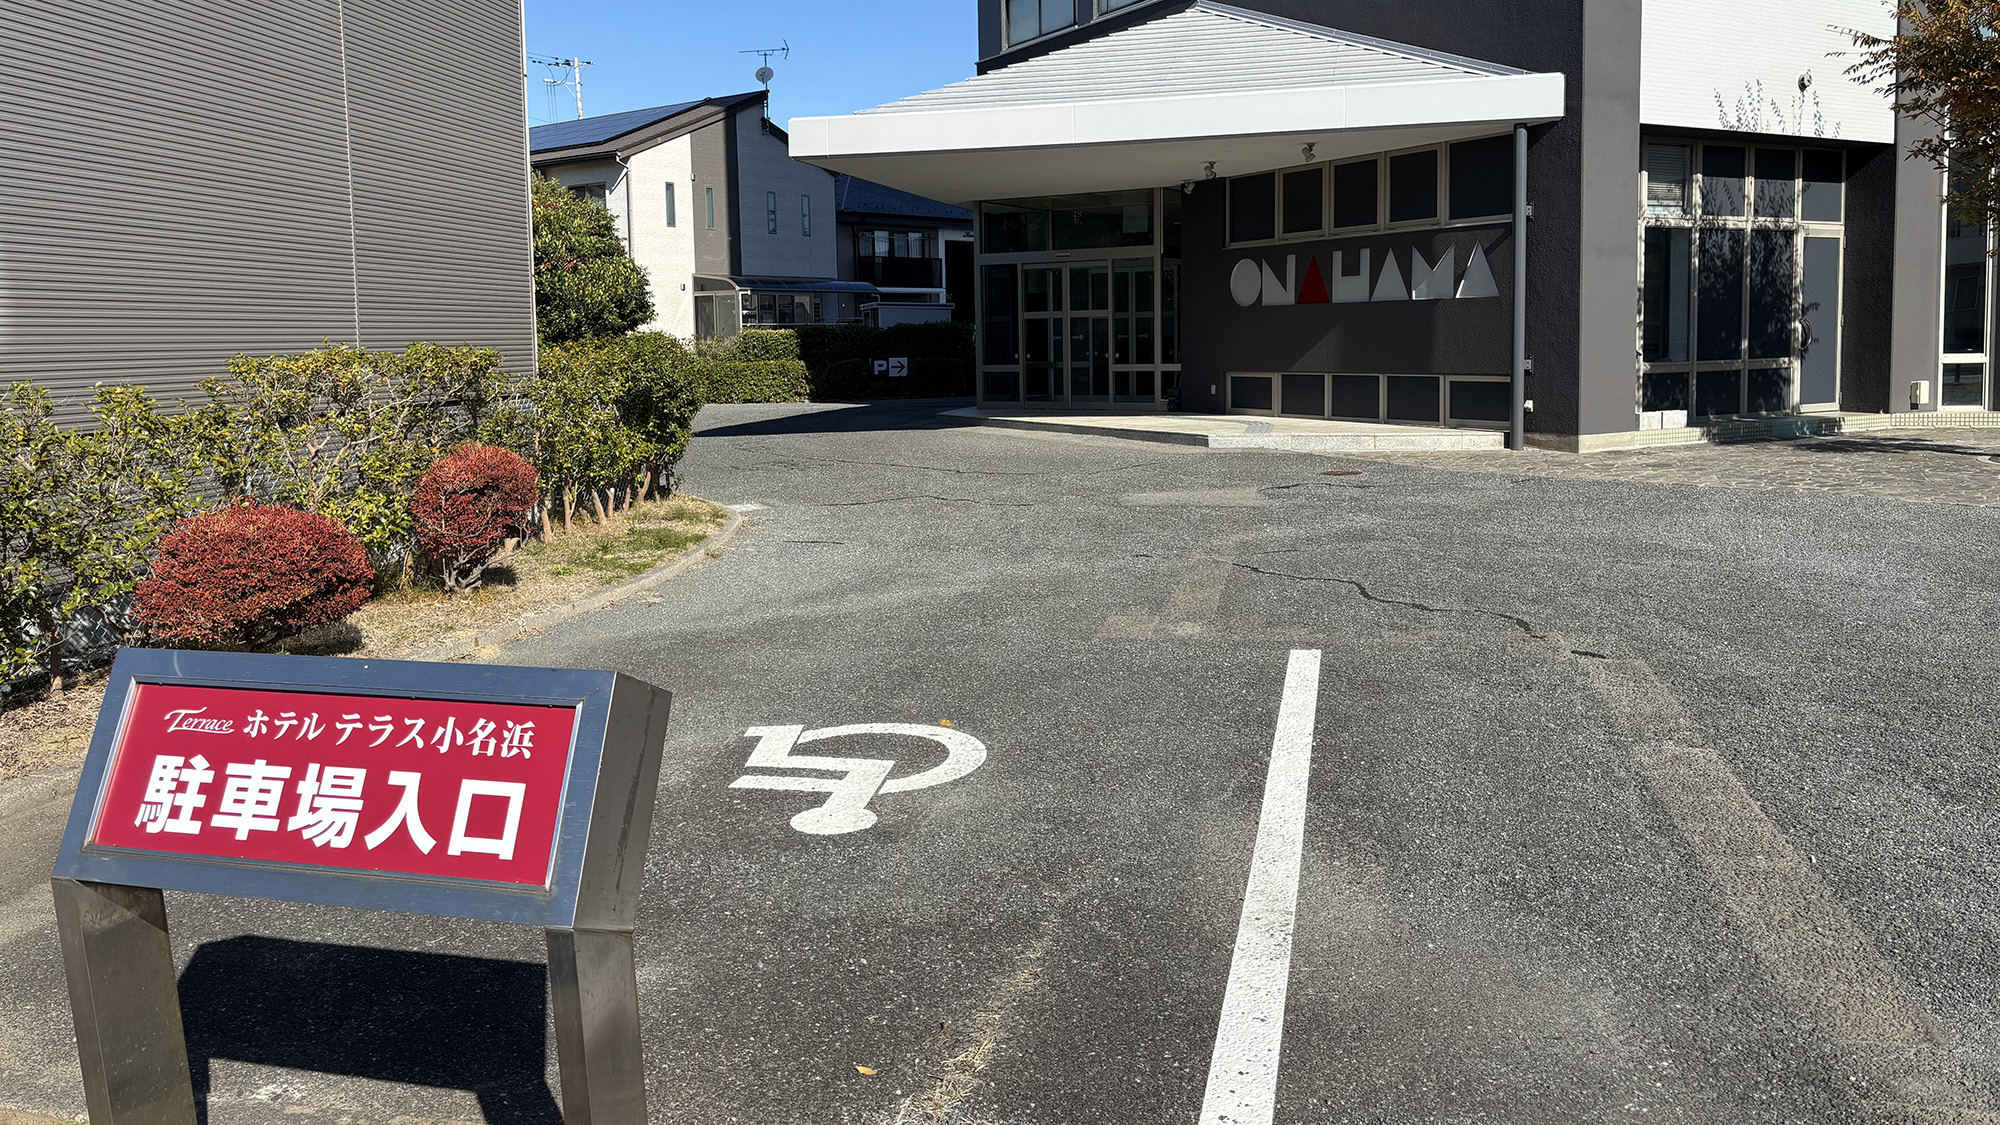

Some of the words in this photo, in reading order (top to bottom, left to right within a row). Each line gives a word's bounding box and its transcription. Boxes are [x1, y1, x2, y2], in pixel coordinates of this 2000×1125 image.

[1230, 241, 1500, 307] ONAHAMA
[874, 360, 888, 375] P
[164, 706, 235, 734] Terrace
[134, 753, 527, 861] 駐車場入口
